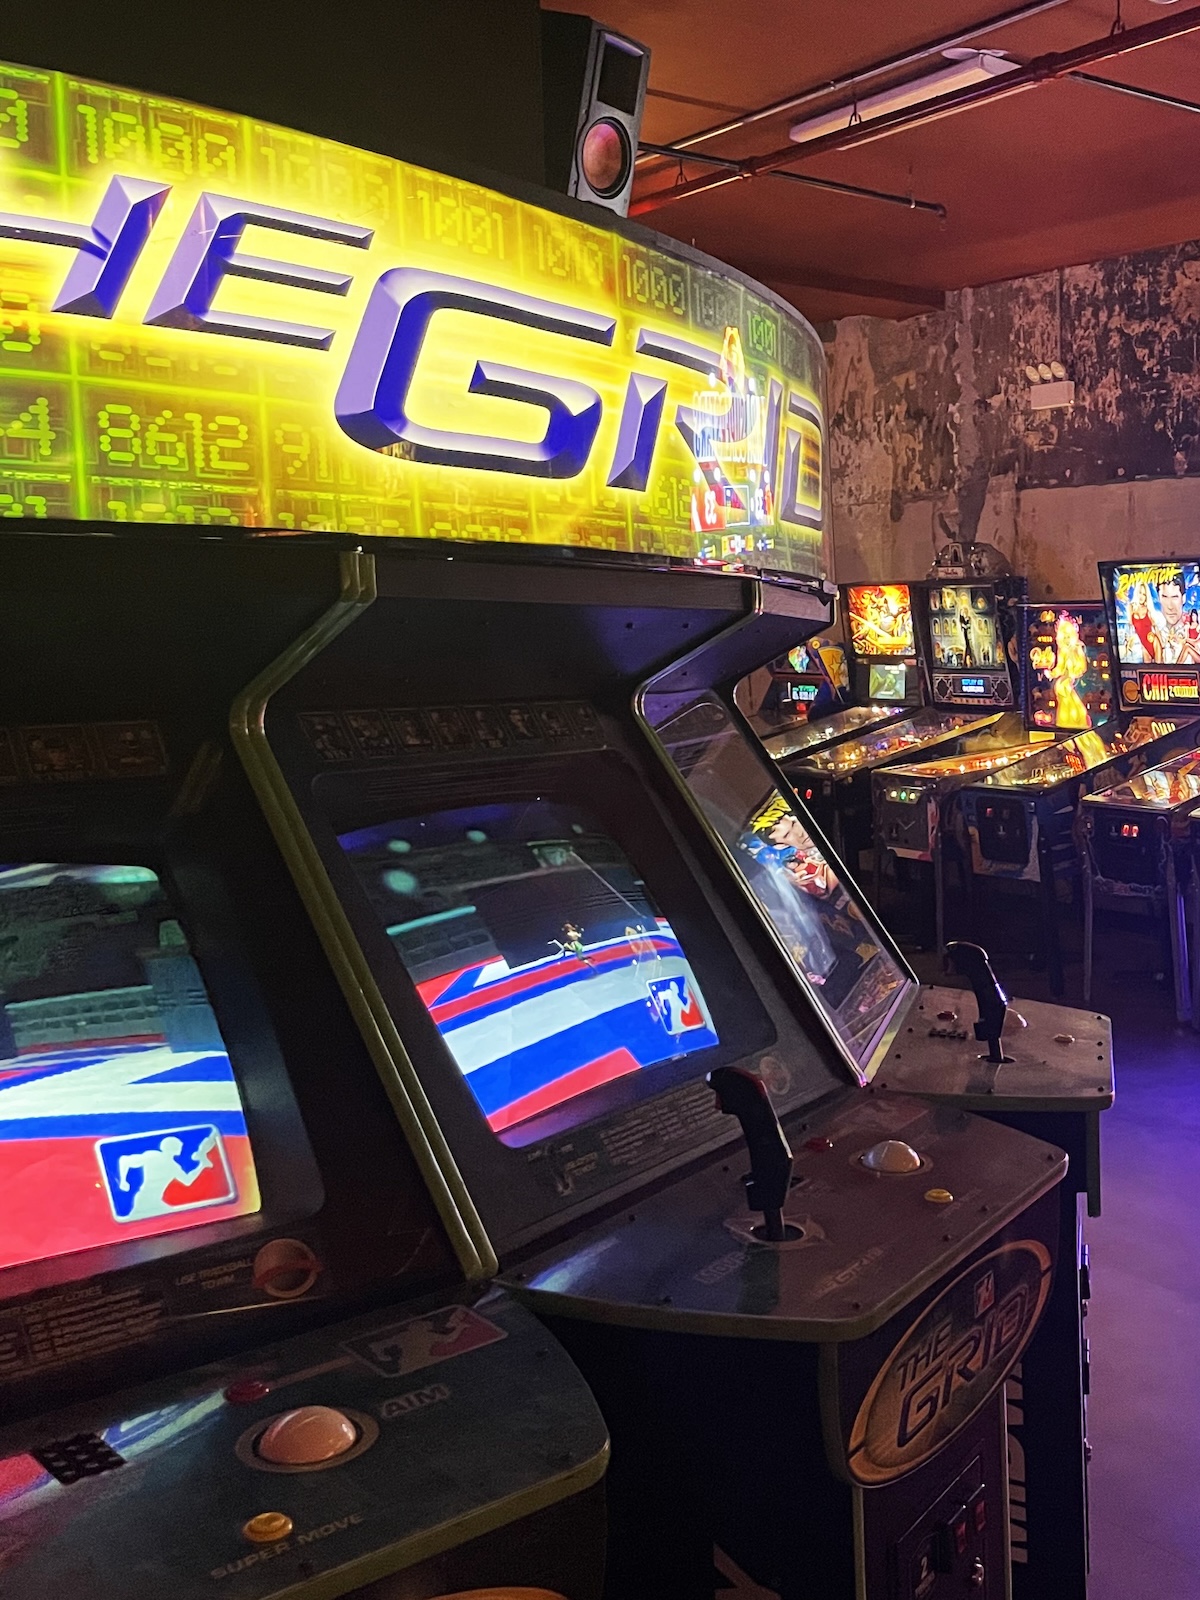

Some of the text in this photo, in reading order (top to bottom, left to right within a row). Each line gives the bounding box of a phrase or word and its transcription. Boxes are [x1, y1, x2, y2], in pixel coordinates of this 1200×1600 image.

[98, 403, 250, 471] 8612
[1116, 566, 1183, 602] BAYWATCH
[896, 1313, 953, 1391] THE
[897, 1283, 1030, 1448] GRID
[380, 1383, 453, 1419] AIM
[209, 1513, 365, 1581] SUPER MOVE
